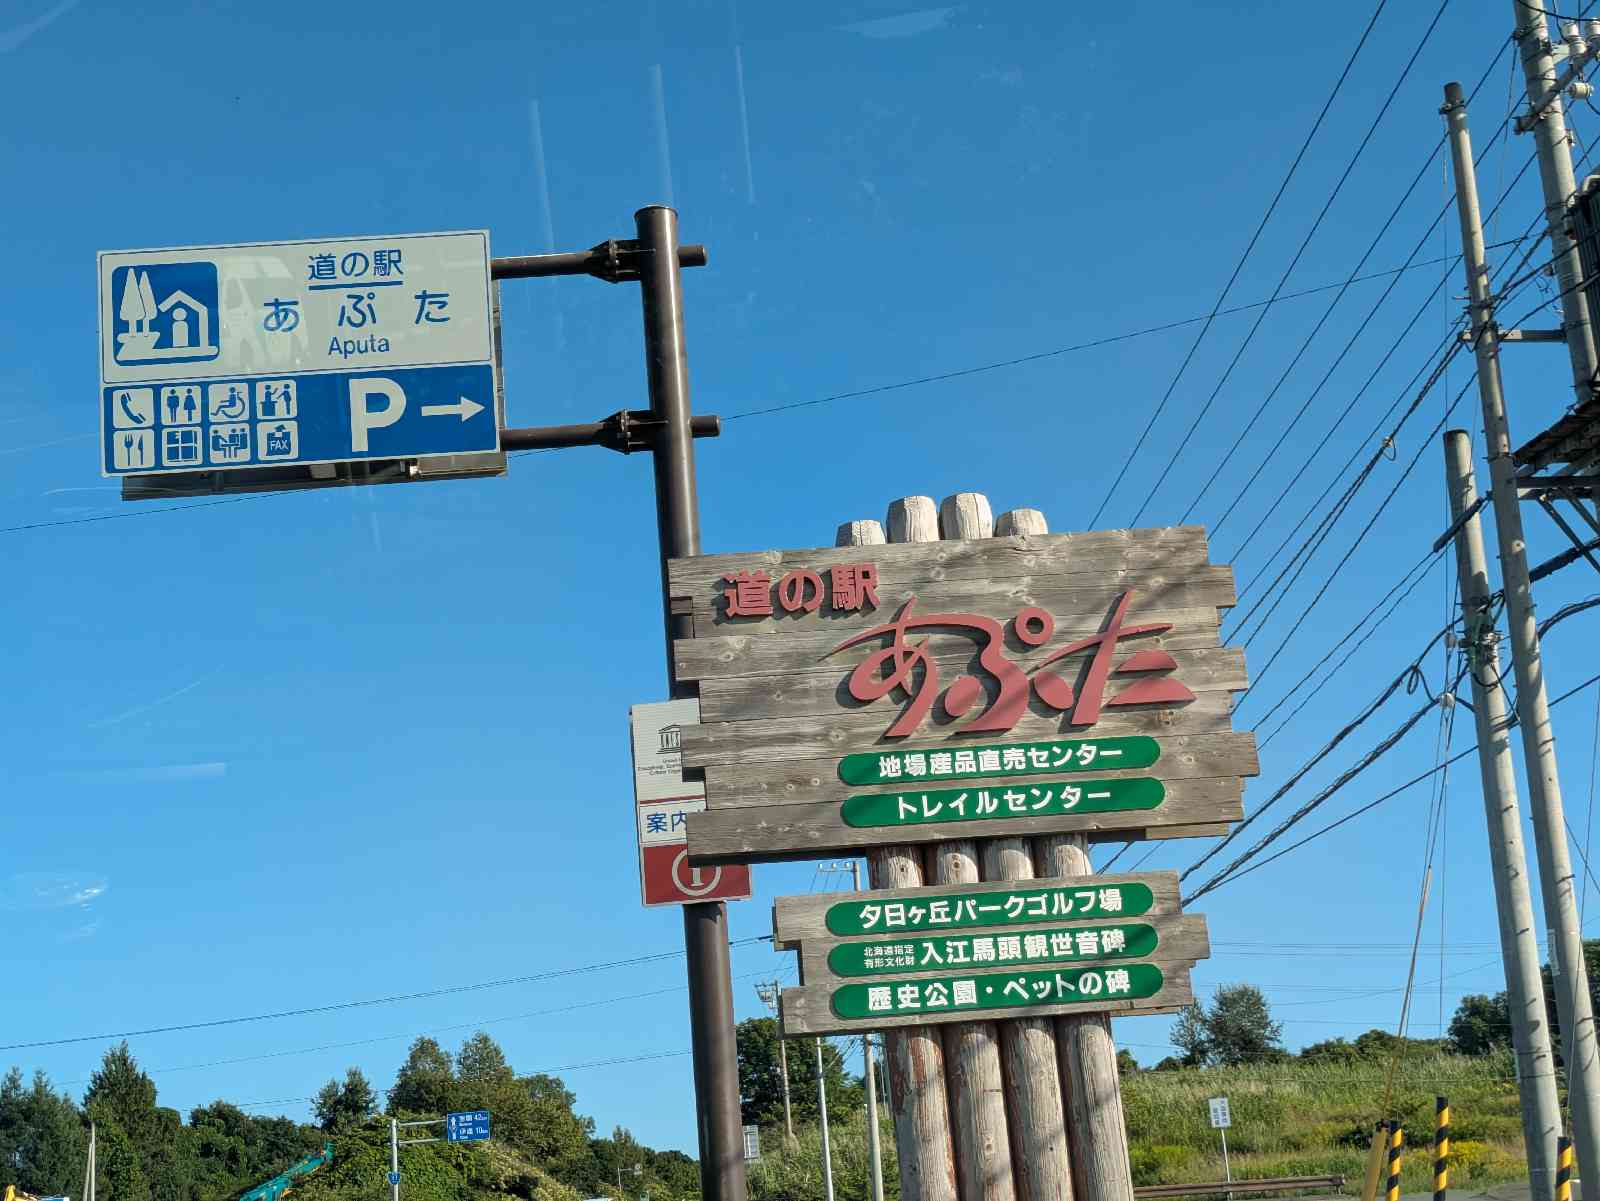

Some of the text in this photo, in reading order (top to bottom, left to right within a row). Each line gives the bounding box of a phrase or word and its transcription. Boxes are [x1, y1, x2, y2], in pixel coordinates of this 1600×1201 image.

[308, 248, 403, 281] 道の駅
[328, 336, 390, 358] Aputa
[348, 377, 407, 452] P
[270, 439, 289, 451] FAX
[724, 562, 881, 616] 道の駅
[824, 589, 1194, 738] あぷた
[879, 745, 1123, 778] 地場産品直売センター
[897, 788, 1111, 821] トレイルセンター
[919, 929, 1126, 965] 入江馬頭観世音碑
[867, 969, 1131, 1011] 歴史公園・ペットの碑
